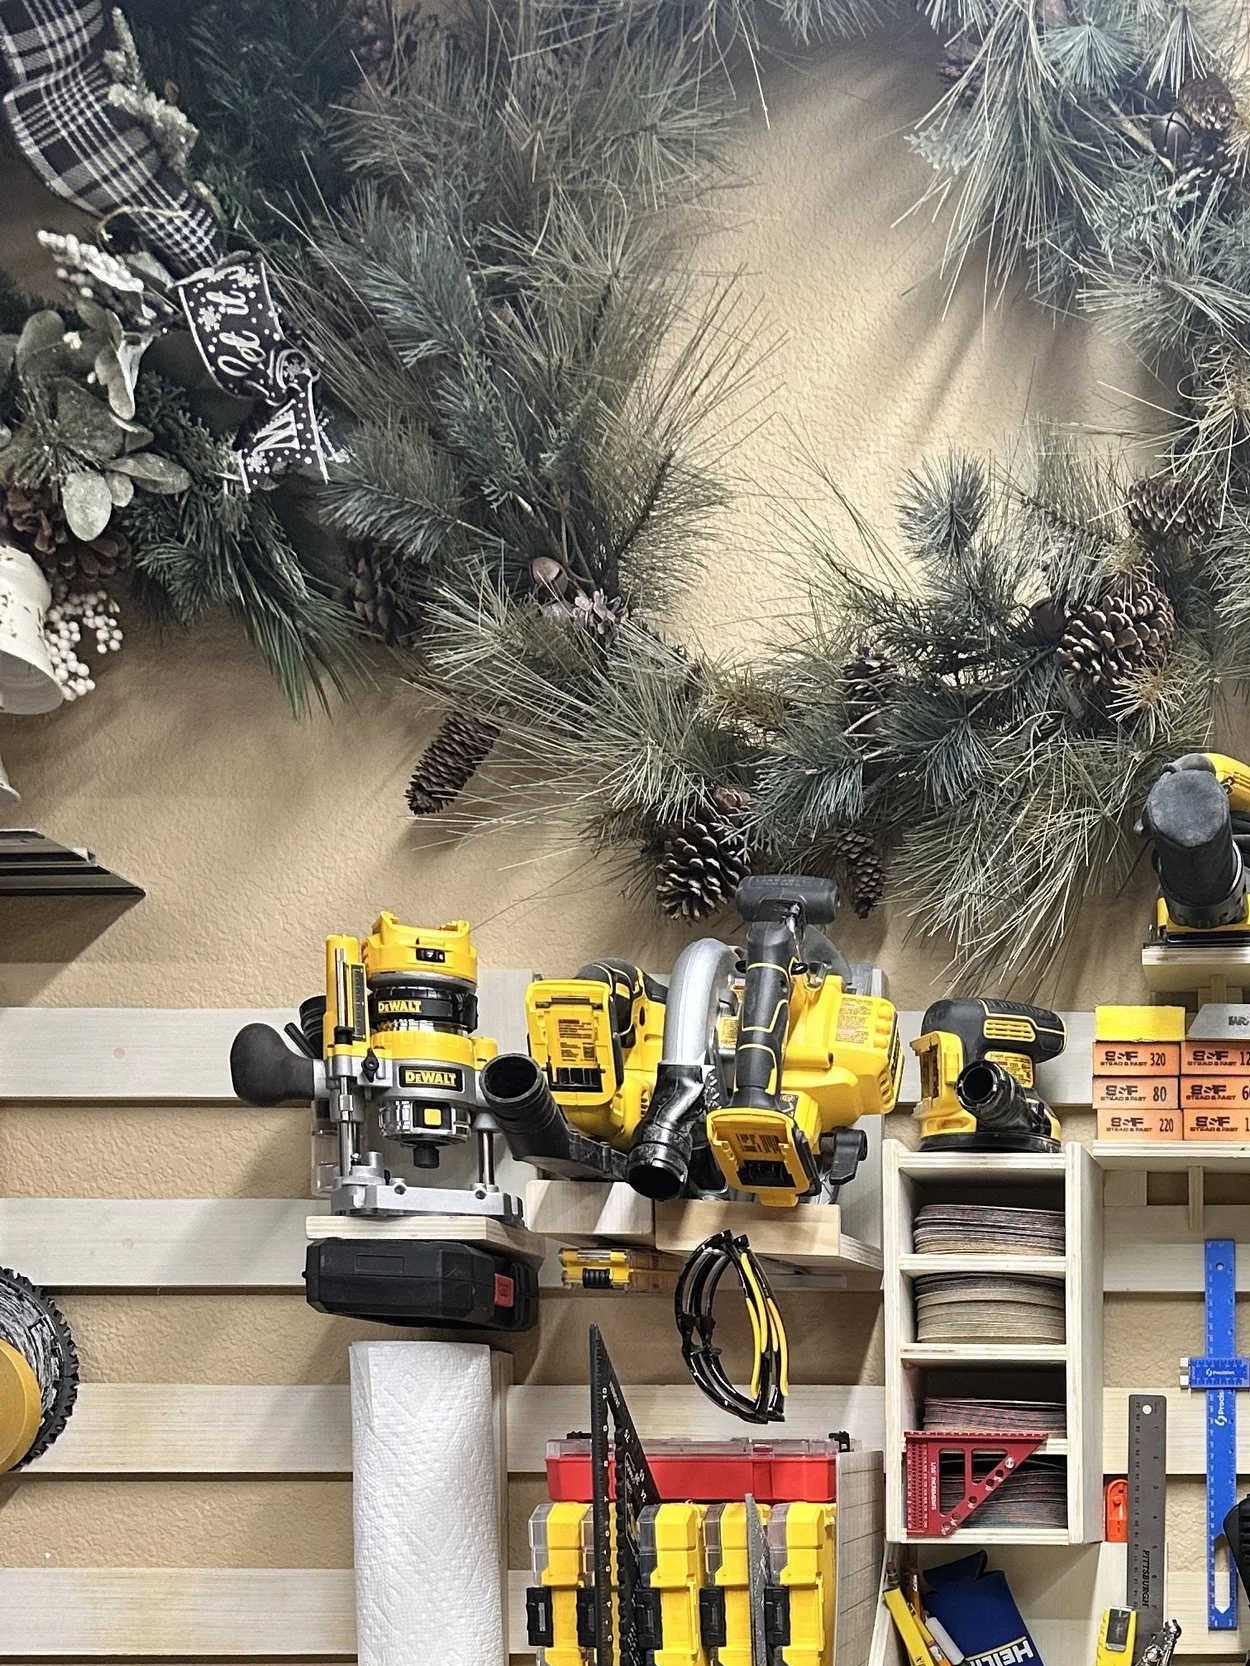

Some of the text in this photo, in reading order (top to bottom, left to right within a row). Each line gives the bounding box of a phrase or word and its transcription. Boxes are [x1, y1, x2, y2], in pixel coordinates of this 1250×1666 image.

[1150, 1052, 1166, 1067] 320
[1153, 1086, 1167, 1102] 80
[1159, 1118, 1174, 1132] 220
[1141, 1549, 1150, 1607] PITTSBURGH
